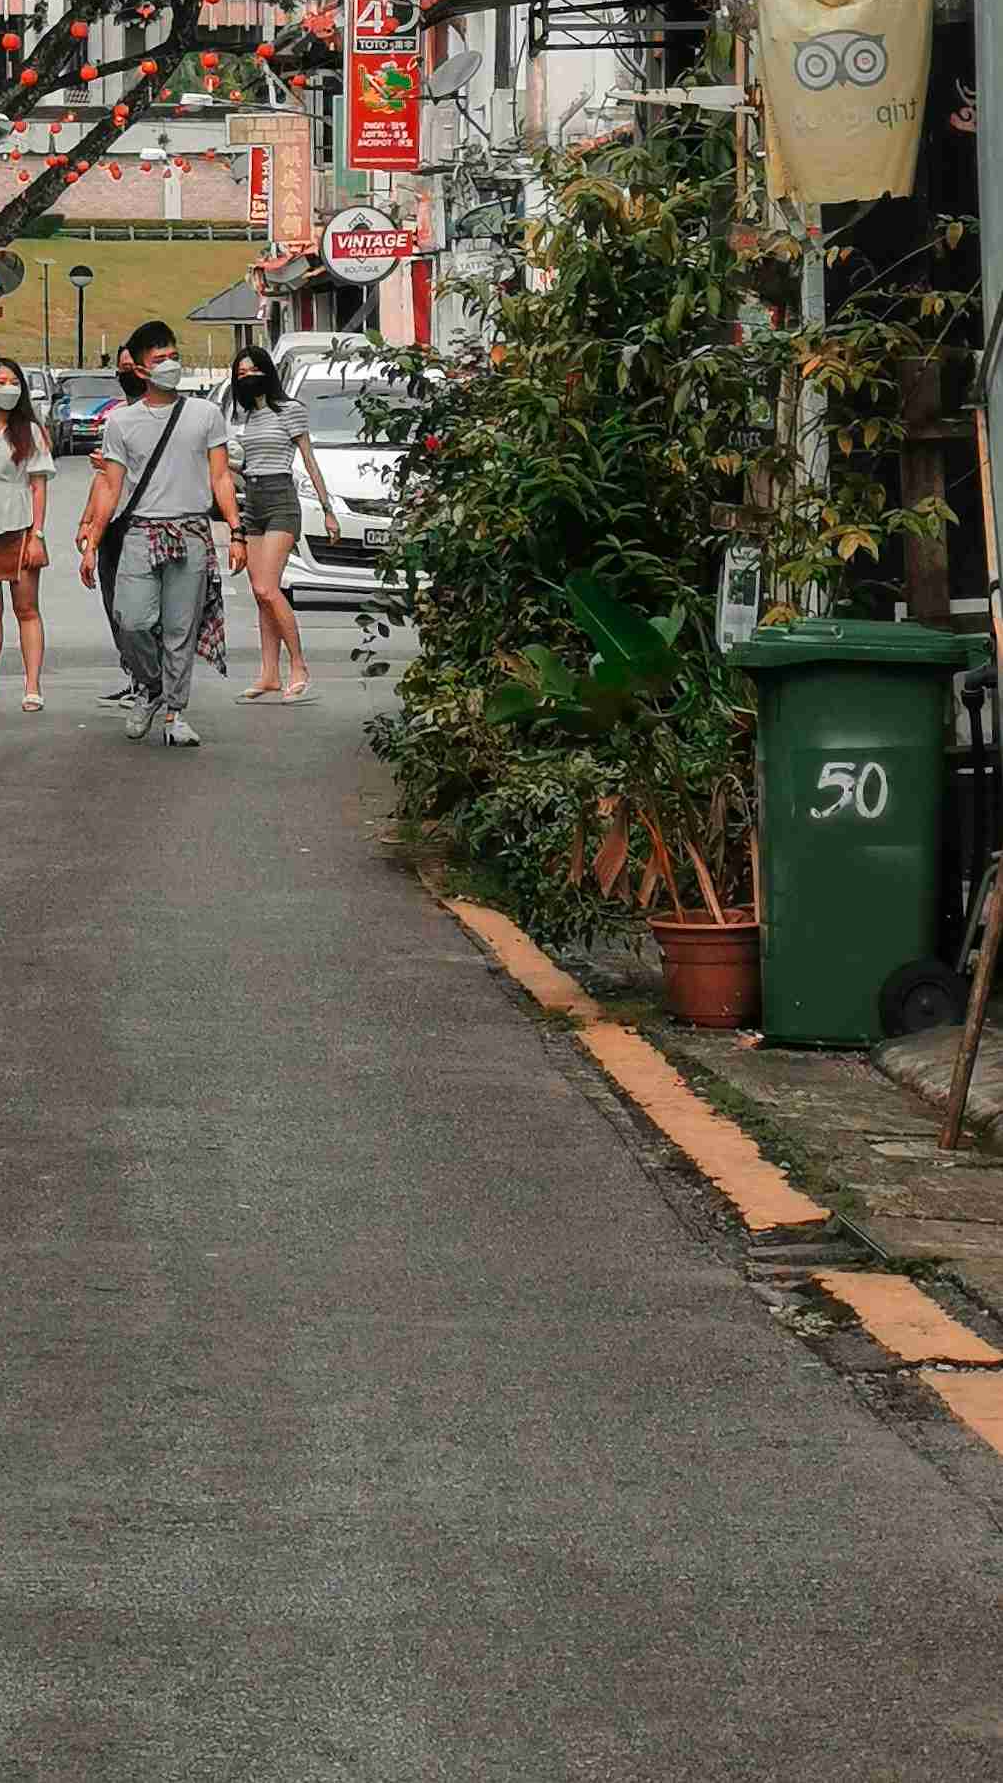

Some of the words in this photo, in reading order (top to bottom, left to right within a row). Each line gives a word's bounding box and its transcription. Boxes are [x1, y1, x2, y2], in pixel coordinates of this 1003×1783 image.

[337, 232, 409, 250] VINTAGE
[349, 247, 394, 257] GALLERY
[810, 762, 889, 819] 50
